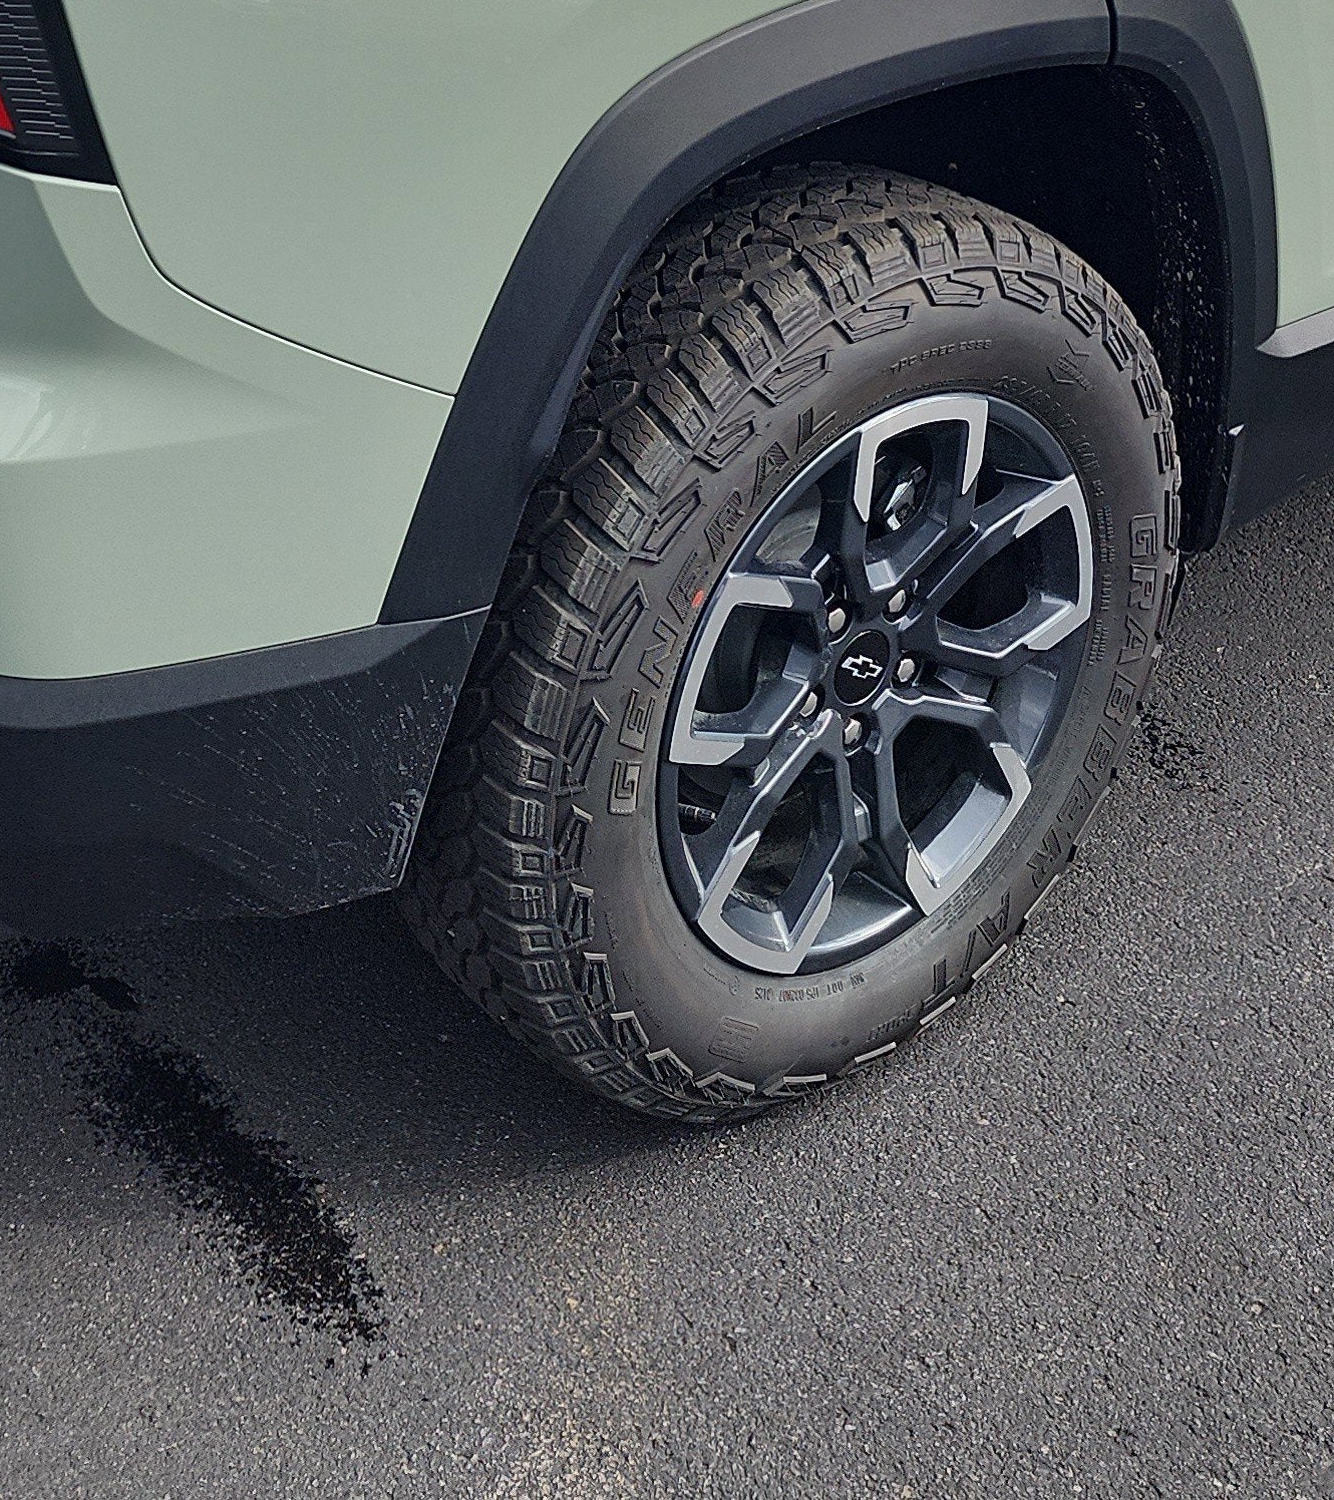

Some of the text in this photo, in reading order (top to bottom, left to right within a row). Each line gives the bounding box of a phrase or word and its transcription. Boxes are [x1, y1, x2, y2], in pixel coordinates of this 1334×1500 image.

[608, 407, 837, 815] GENERAL
[1026, 513, 1159, 889] GRABBER
[921, 892, 1011, 1008] A/T
